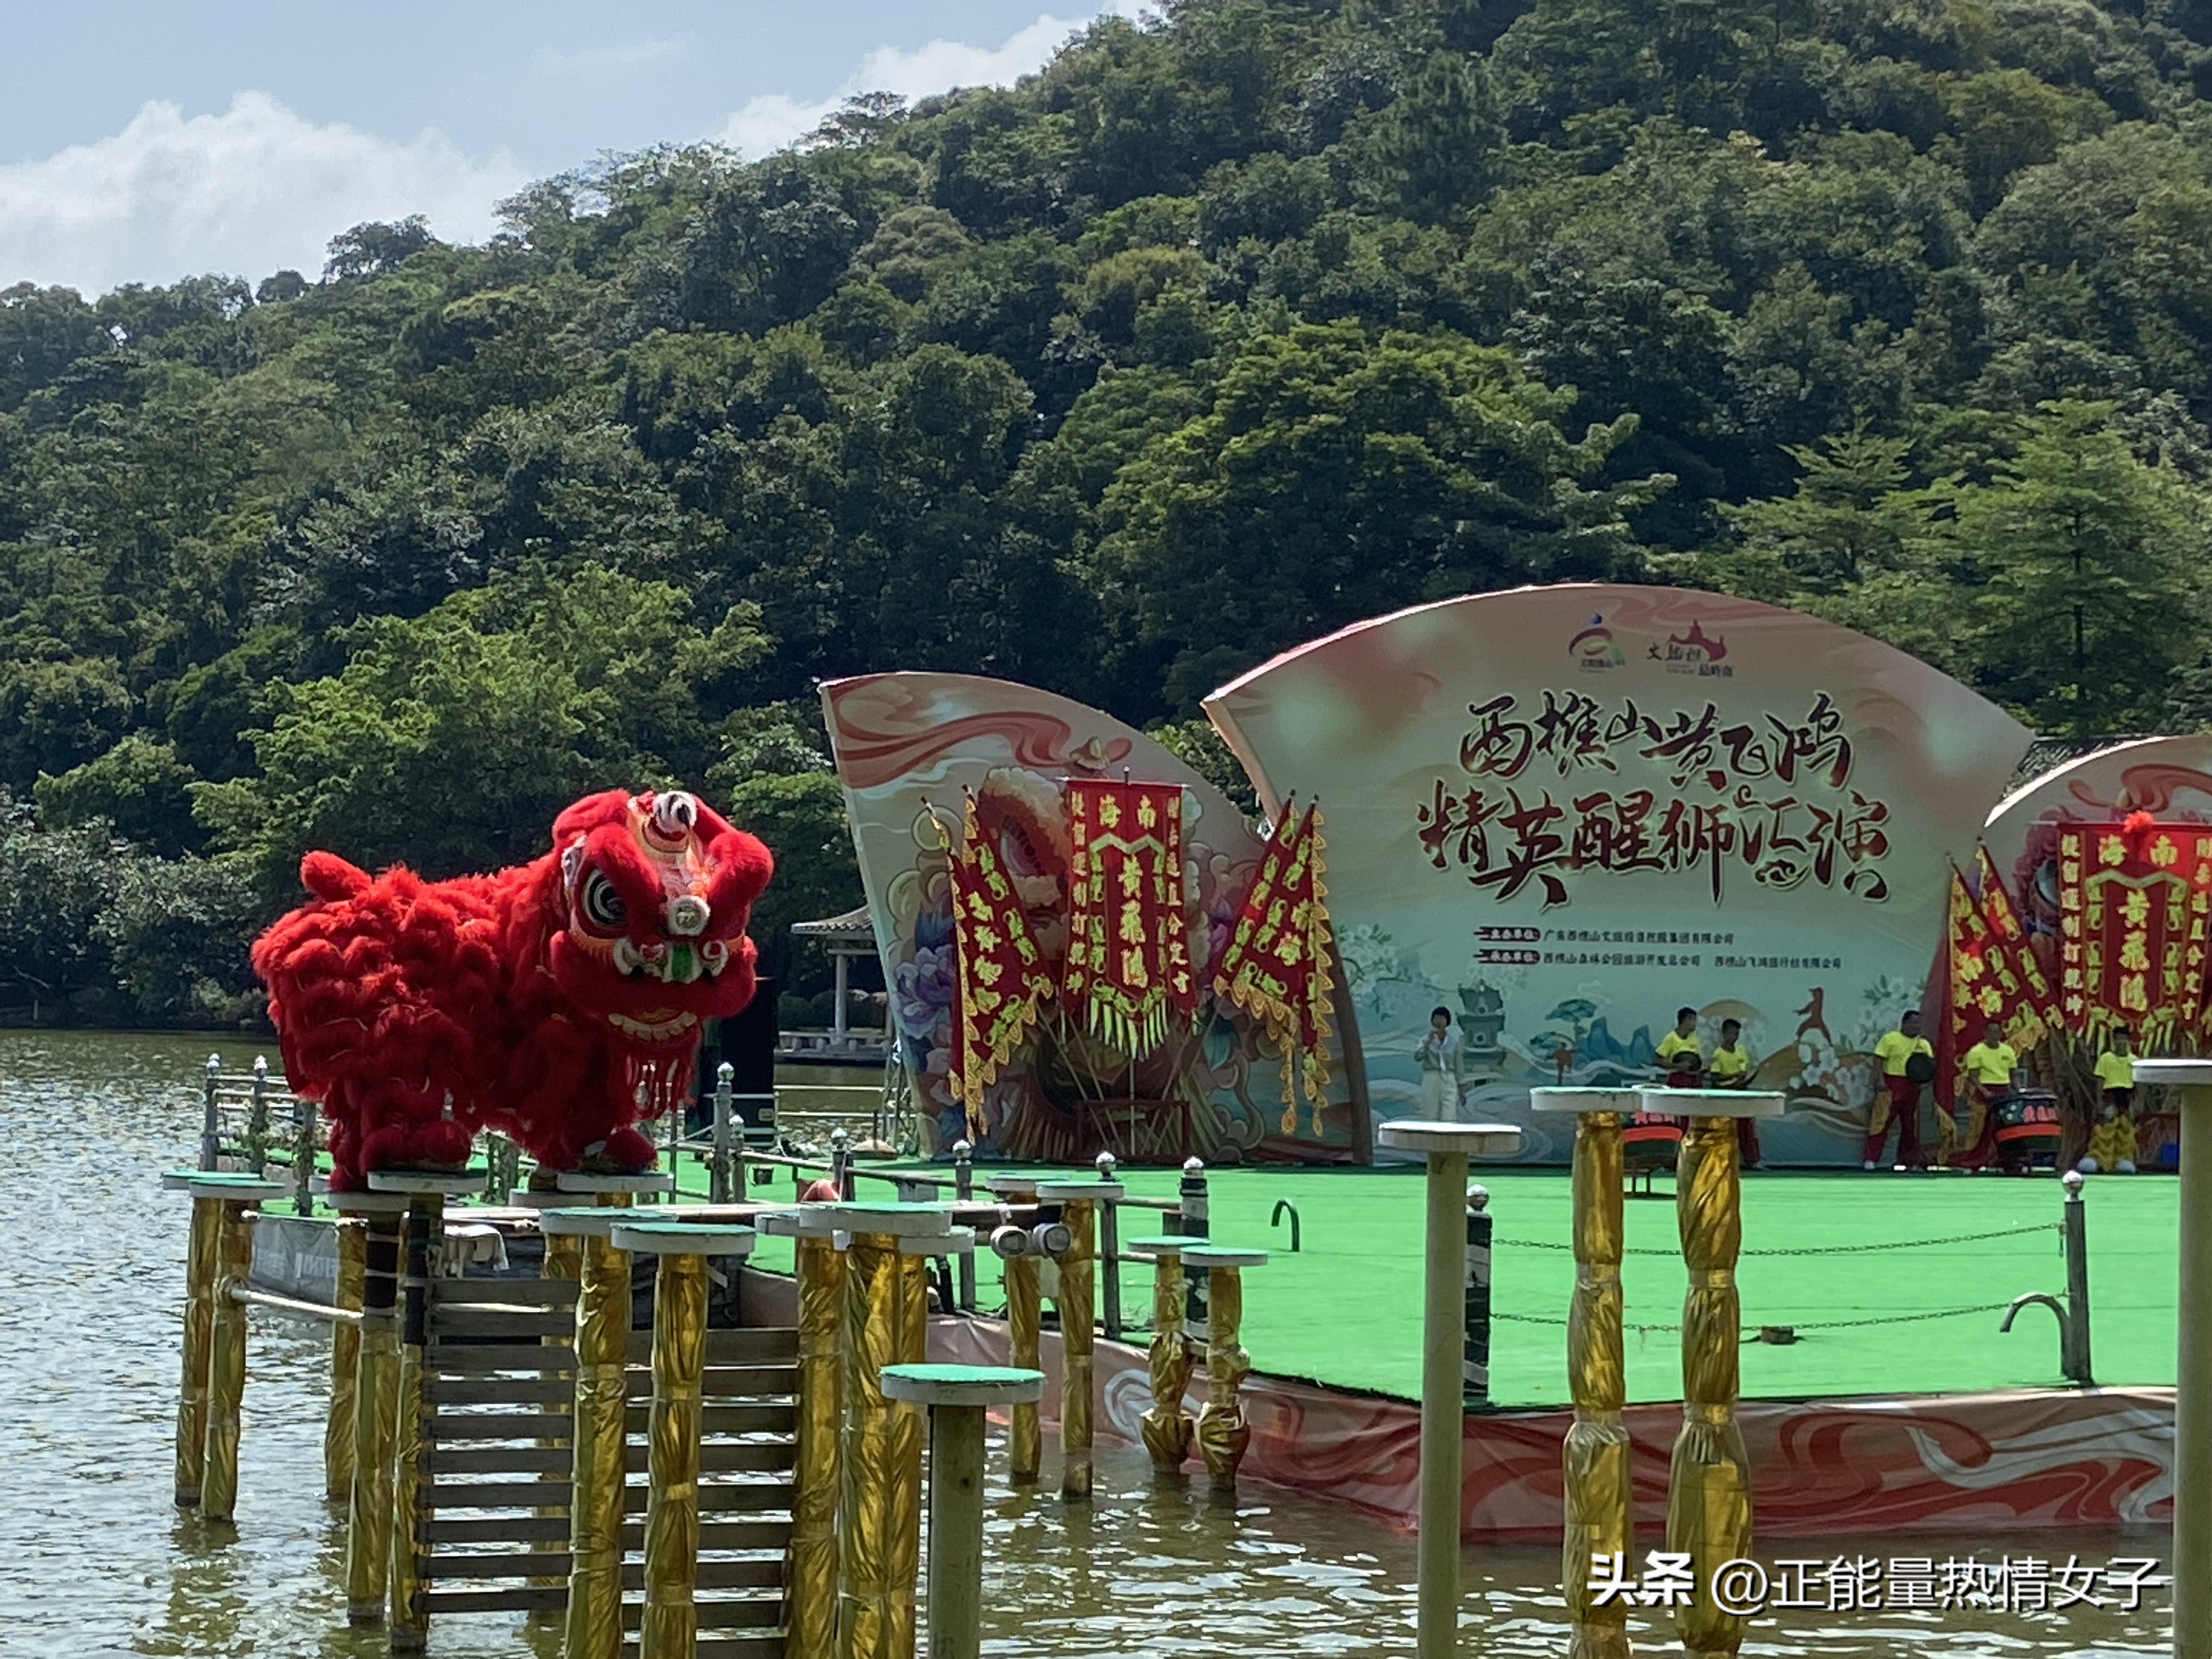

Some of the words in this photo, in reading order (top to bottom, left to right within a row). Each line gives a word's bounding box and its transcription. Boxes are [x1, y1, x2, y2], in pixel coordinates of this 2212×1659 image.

[1460, 691, 1852, 791] 西樵山黄飞鸿
[1419, 780, 1889, 911] 精英醒狮汇演
